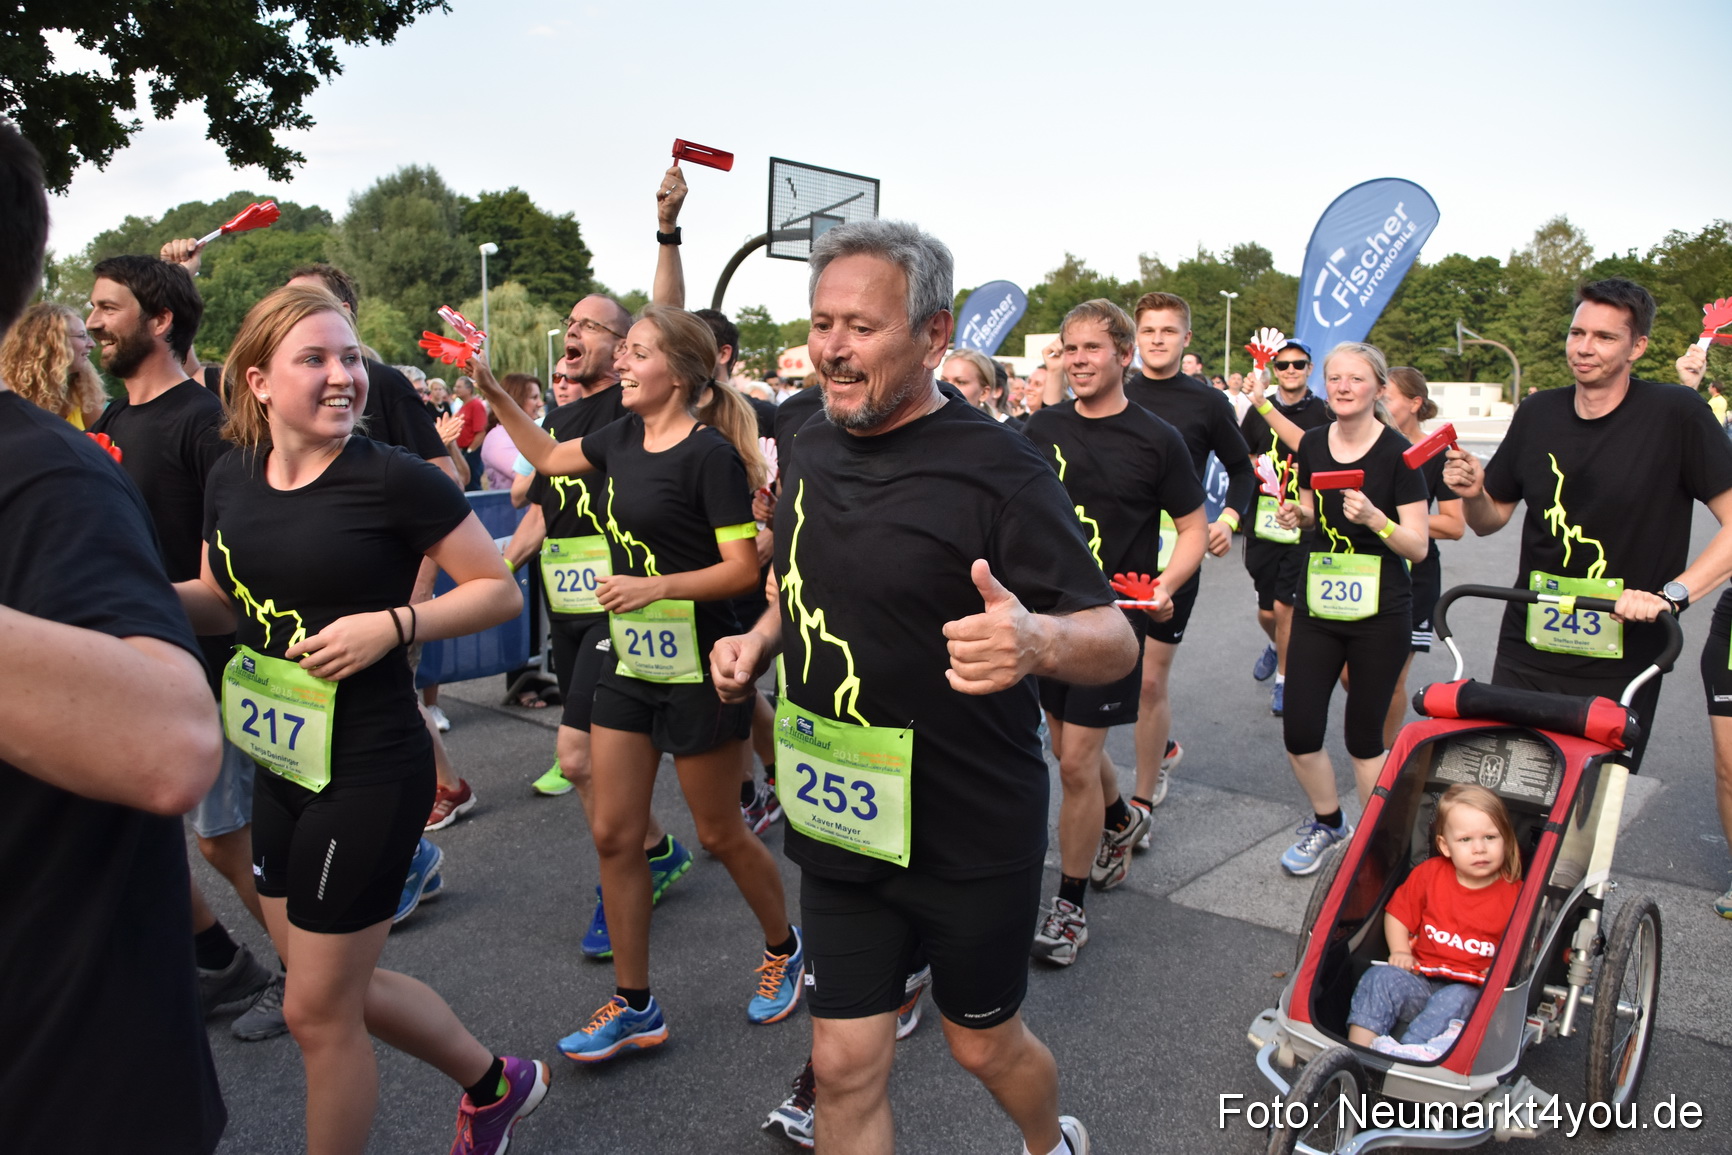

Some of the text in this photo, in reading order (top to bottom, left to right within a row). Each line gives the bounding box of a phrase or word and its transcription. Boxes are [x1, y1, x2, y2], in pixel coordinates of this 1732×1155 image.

[1331, 201, 1409, 309] Fischer
[1358, 221, 1417, 307] AUTOMOBILE
[971, 293, 1013, 348] Fischer
[554, 568, 598, 592] 220
[1320, 580, 1363, 602] 230
[1543, 607, 1602, 636] 243
[625, 628, 678, 658] 218
[241, 698, 305, 751] 217
[789, 725, 832, 750] firmenlauf
[833, 748, 861, 763] 2015
[796, 762, 878, 821] 253
[811, 813, 862, 835] Xaver Mayer
[1424, 924, 1496, 957] COACH
